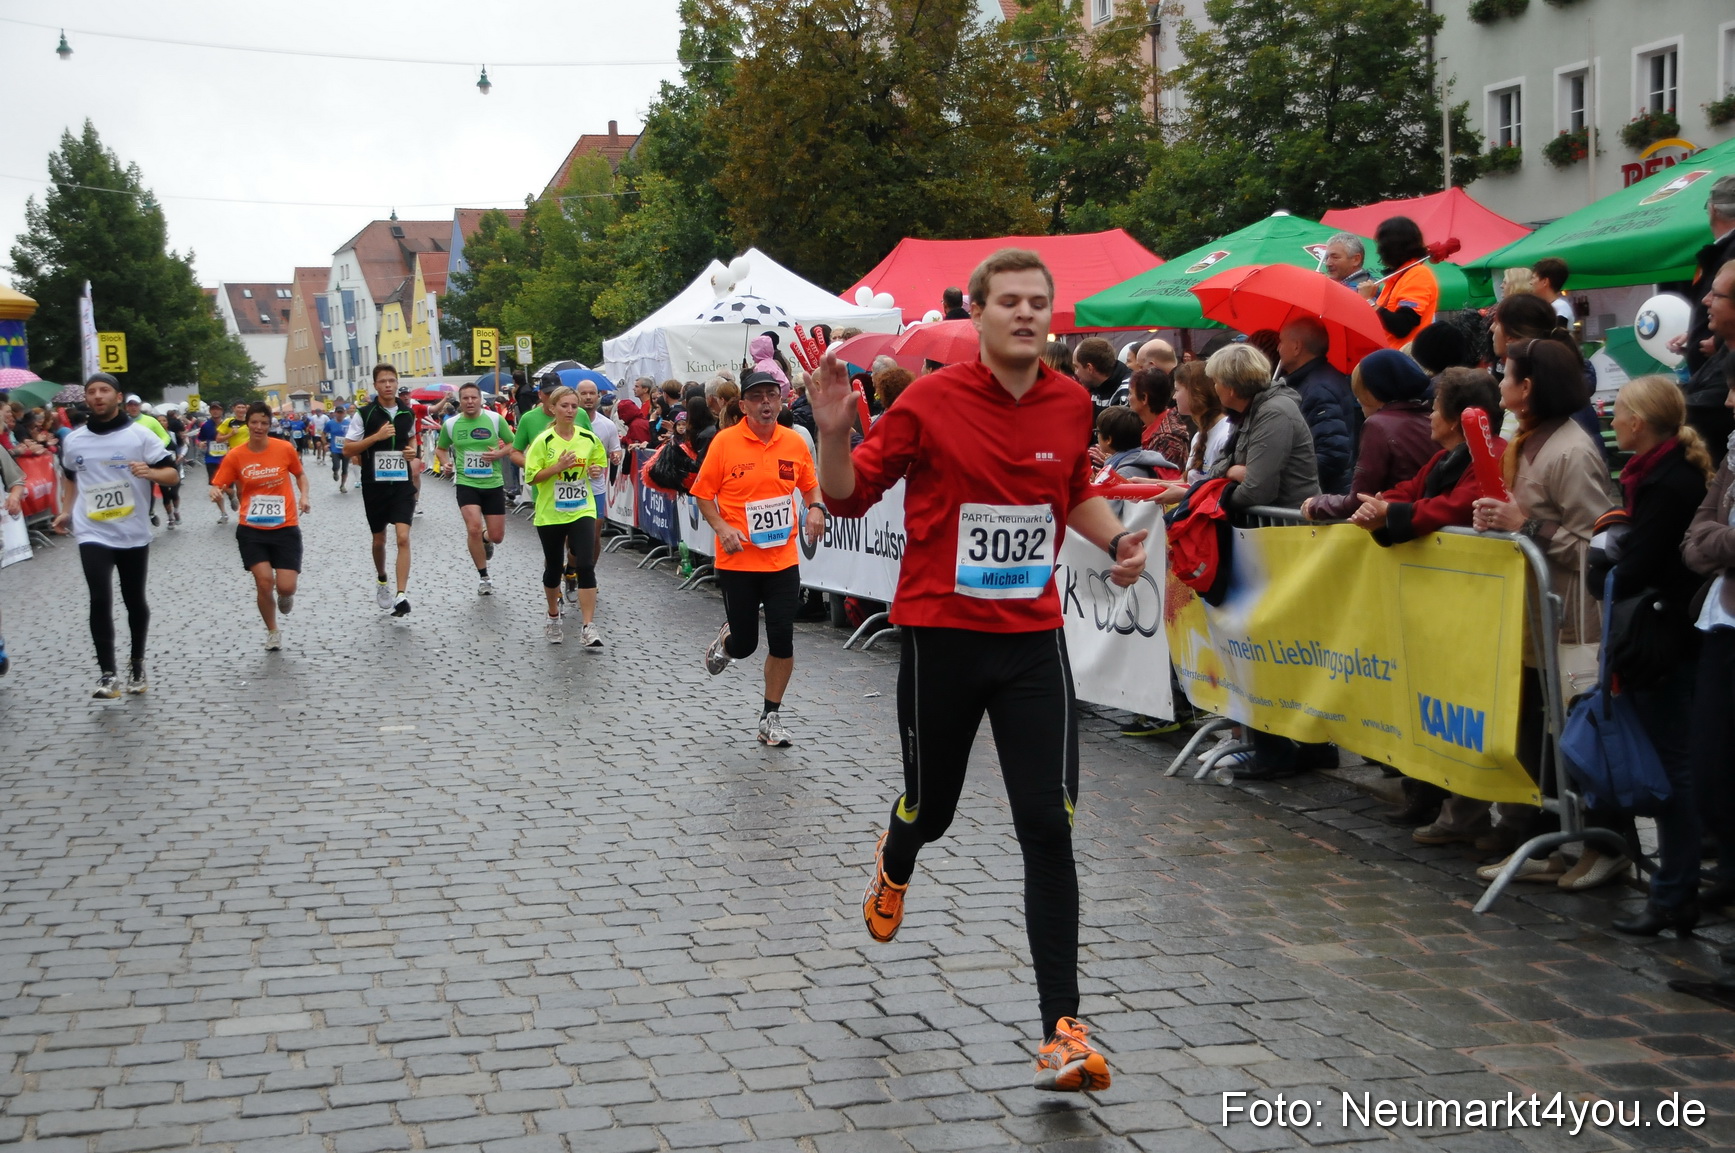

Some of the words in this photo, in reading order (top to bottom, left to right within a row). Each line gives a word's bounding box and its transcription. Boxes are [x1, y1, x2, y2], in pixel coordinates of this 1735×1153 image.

[1621, 149, 1708, 188] REN
[101, 334, 122, 342] Block
[477, 329, 496, 337] Block
[105, 345, 120, 364] B
[480, 340, 493, 358] B
[687, 360, 727, 373] Kinder
[378, 458, 405, 470] 2876
[94, 490, 125, 510] 220
[558, 486, 588, 500] 2026
[251, 503, 282, 516] 2783
[752, 507, 790, 531] 2917
[962, 513, 996, 524] PARTL
[998, 515, 1043, 525] Neumarkt
[767, 532, 785, 541] Hans
[823, 513, 860, 553] BMW
[968, 527, 1047, 563] 3032
[981, 570, 1030, 586] Michael
[1418, 692, 1485, 753] KANN
